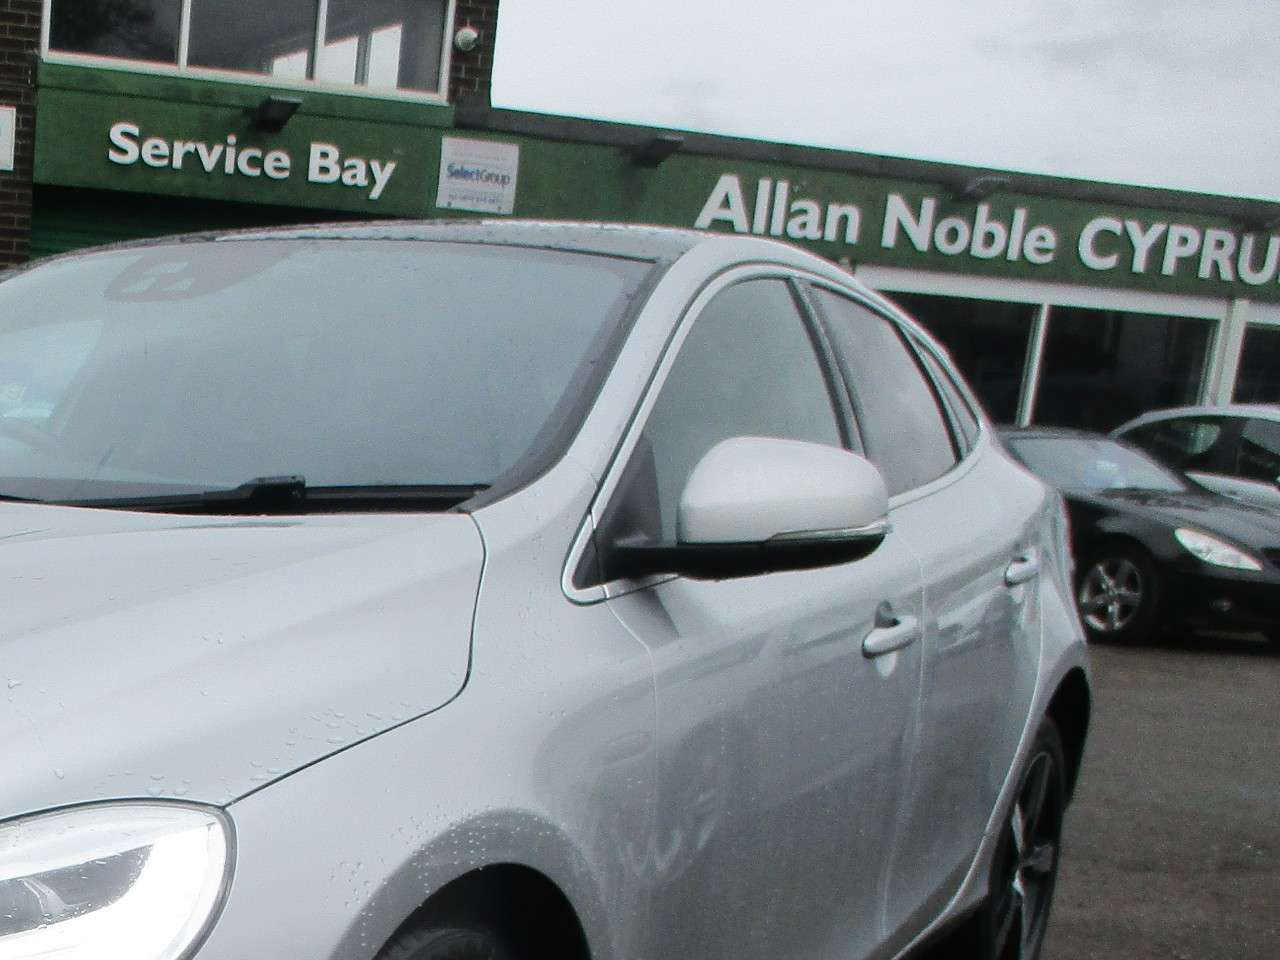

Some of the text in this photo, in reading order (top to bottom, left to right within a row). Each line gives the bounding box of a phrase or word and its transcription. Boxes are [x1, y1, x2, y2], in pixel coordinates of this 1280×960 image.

[108, 121, 397, 200] Service Bay
[694, 173, 1280, 286] Allan Noble CYPRU
